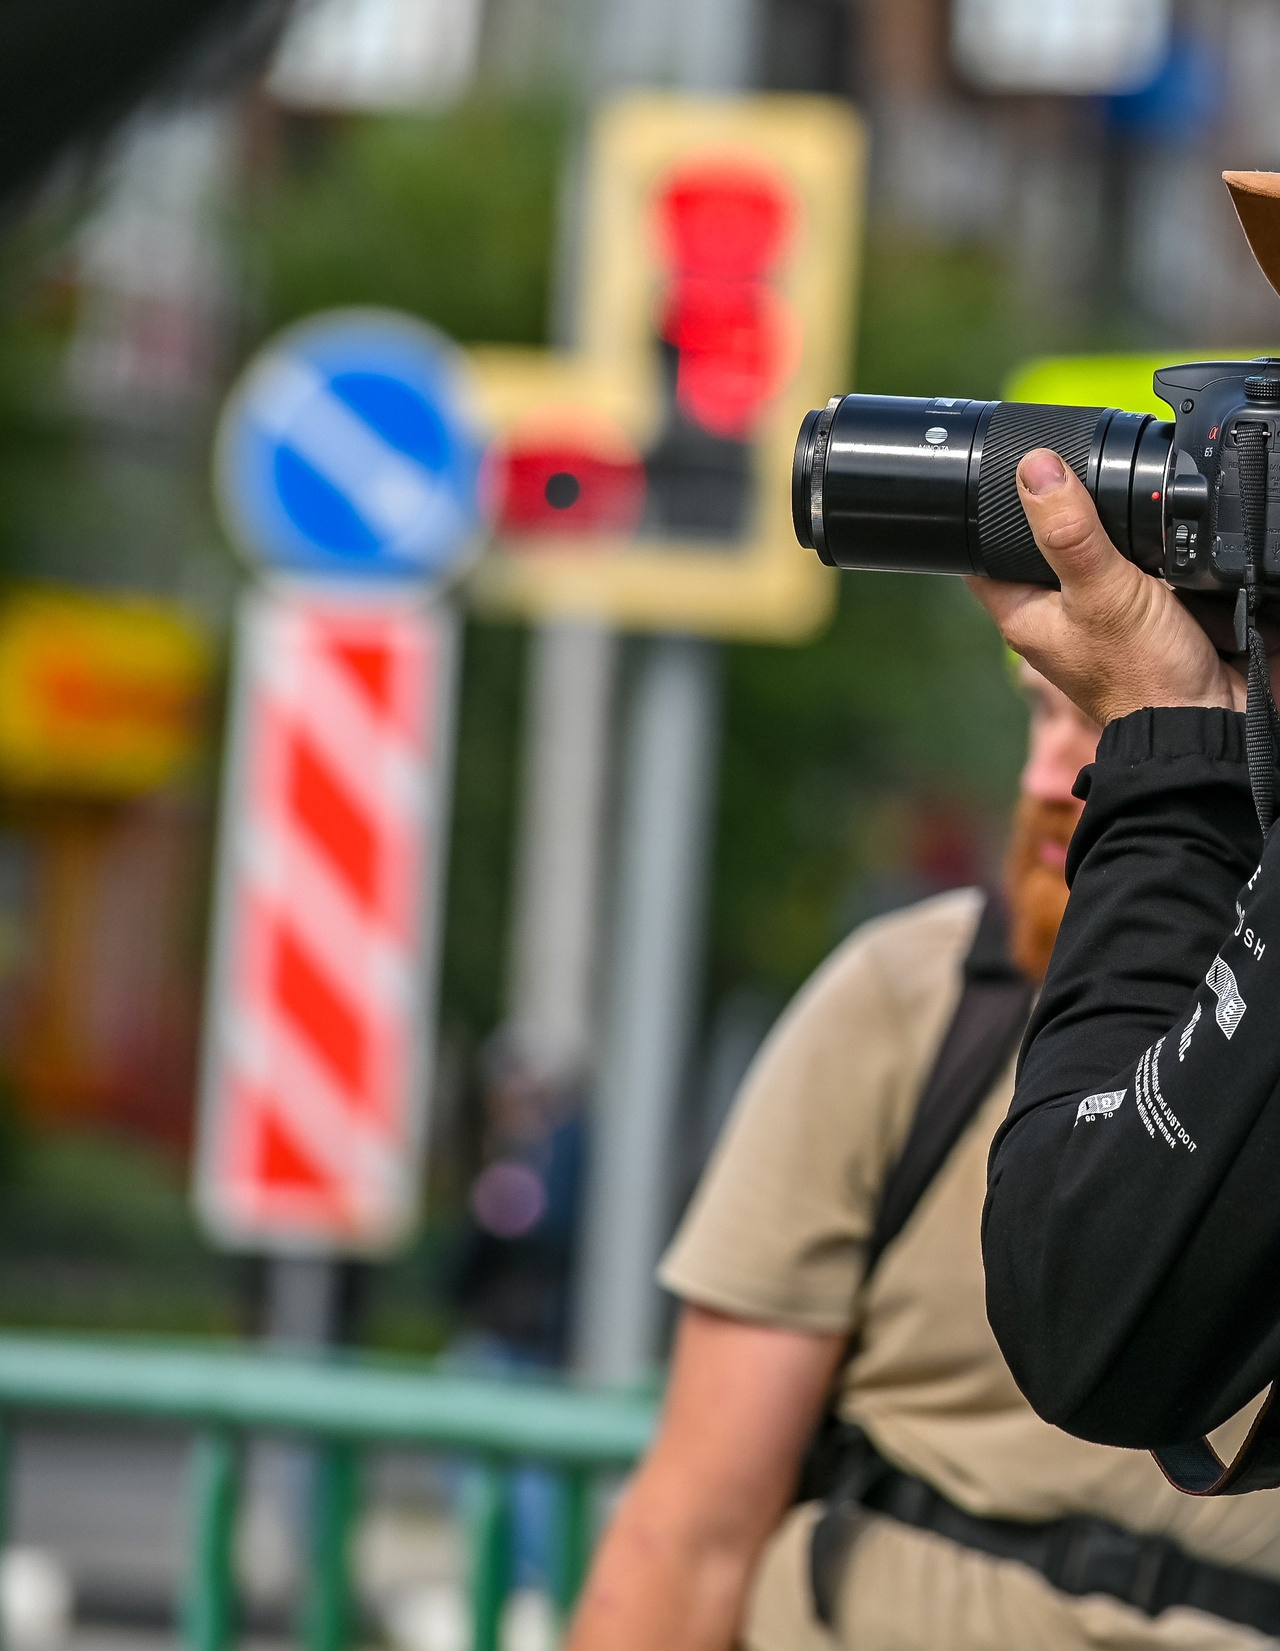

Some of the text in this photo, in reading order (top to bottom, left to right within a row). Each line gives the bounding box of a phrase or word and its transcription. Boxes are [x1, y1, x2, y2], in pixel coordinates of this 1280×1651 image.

[1204, 447, 1213, 457] 65
[1103, 1111, 1114, 1120] 70
[1150, 1106, 1177, 1149] trademark
[1163, 1108, 1181, 1131] JUST
[1177, 1128, 1190, 1145] DO
[1187, 1141, 1198, 1153] IT
